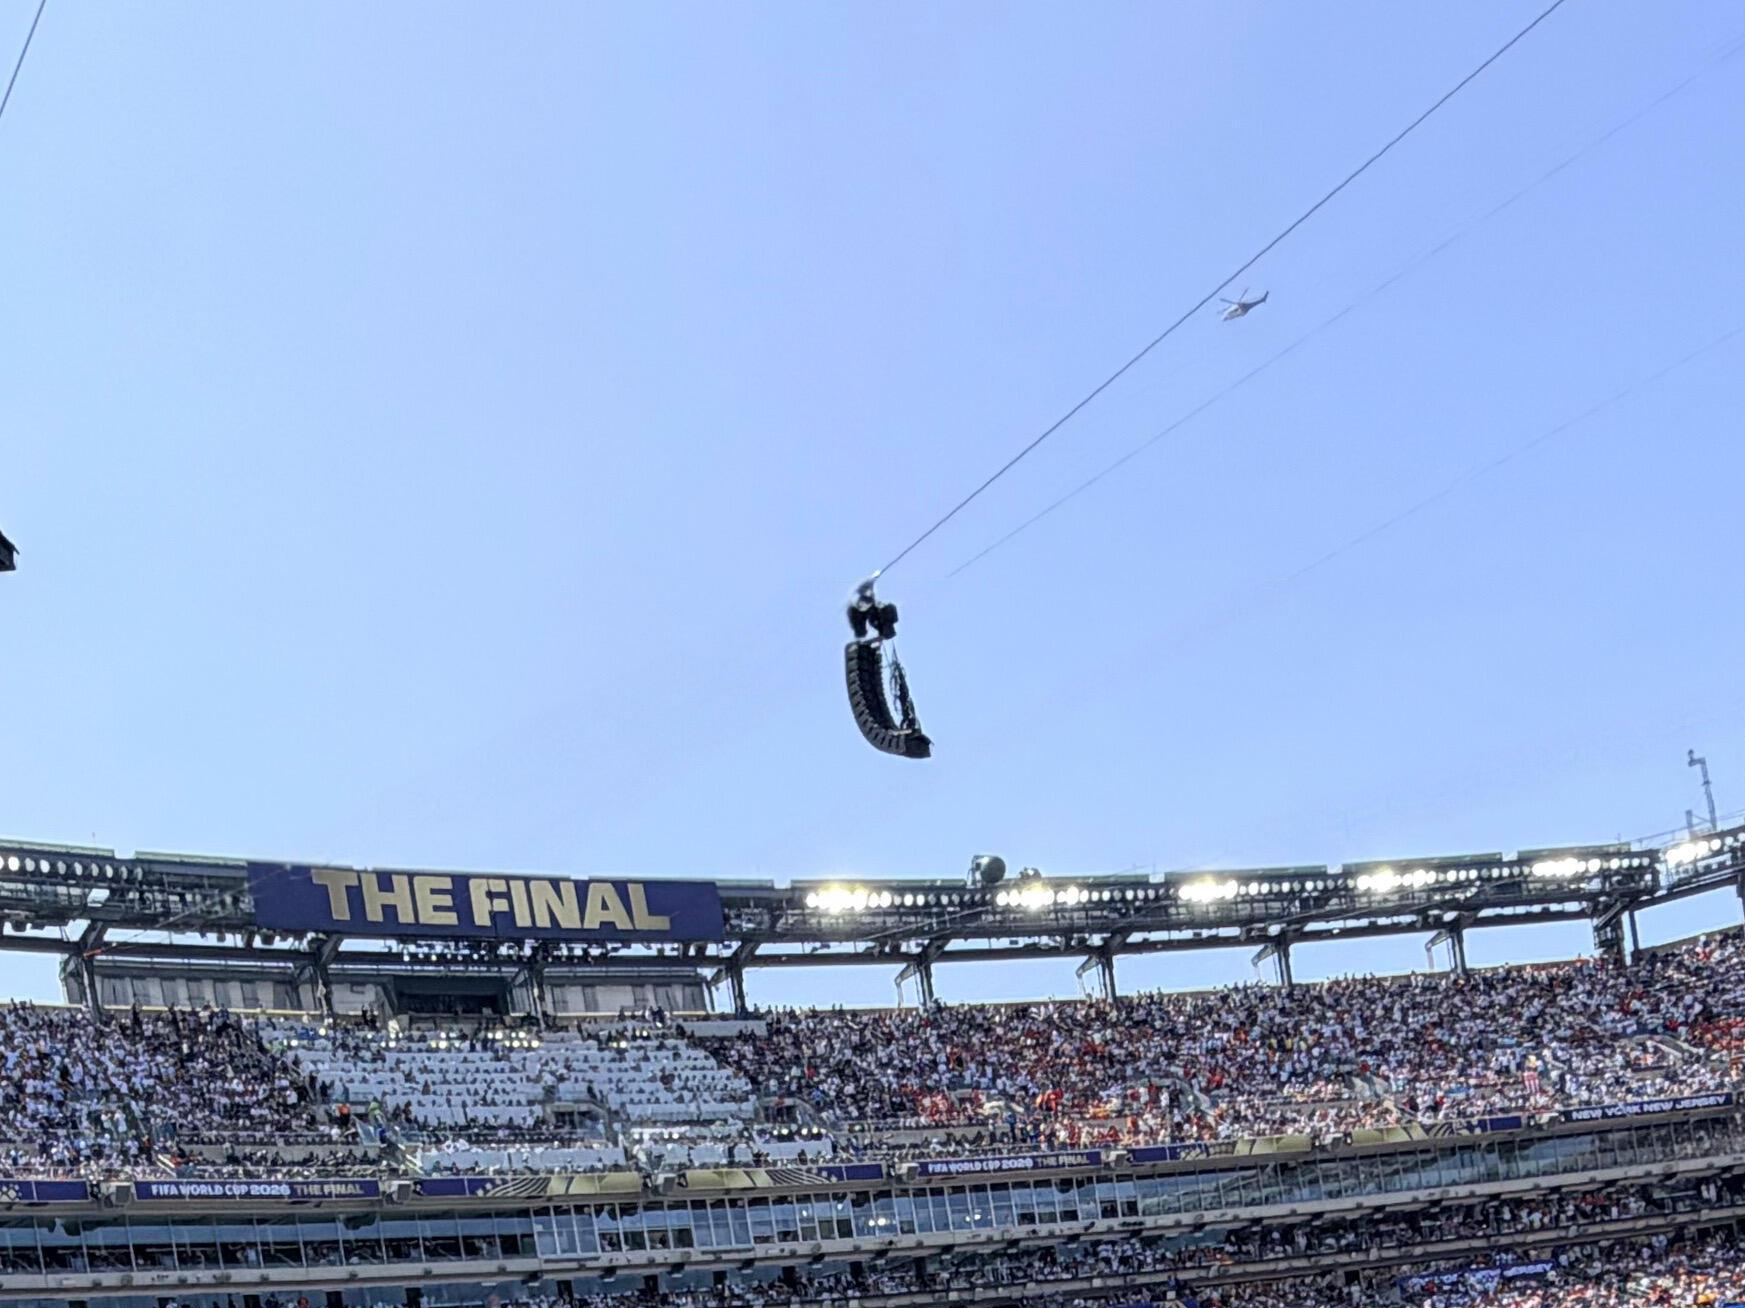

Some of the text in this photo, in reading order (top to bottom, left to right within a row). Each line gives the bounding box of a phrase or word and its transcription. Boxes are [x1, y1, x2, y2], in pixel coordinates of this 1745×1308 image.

[311, 868, 671, 931] THE FINAL
[1572, 1109, 1602, 1120] NEW
[1643, 1100, 1674, 1113] NEW
[928, 1163, 948, 1174] FIFA
[949, 1161, 981, 1173] WORLD
[151, 1183, 364, 1196] FIFA WORLD CUP 2026 THE FINAL
